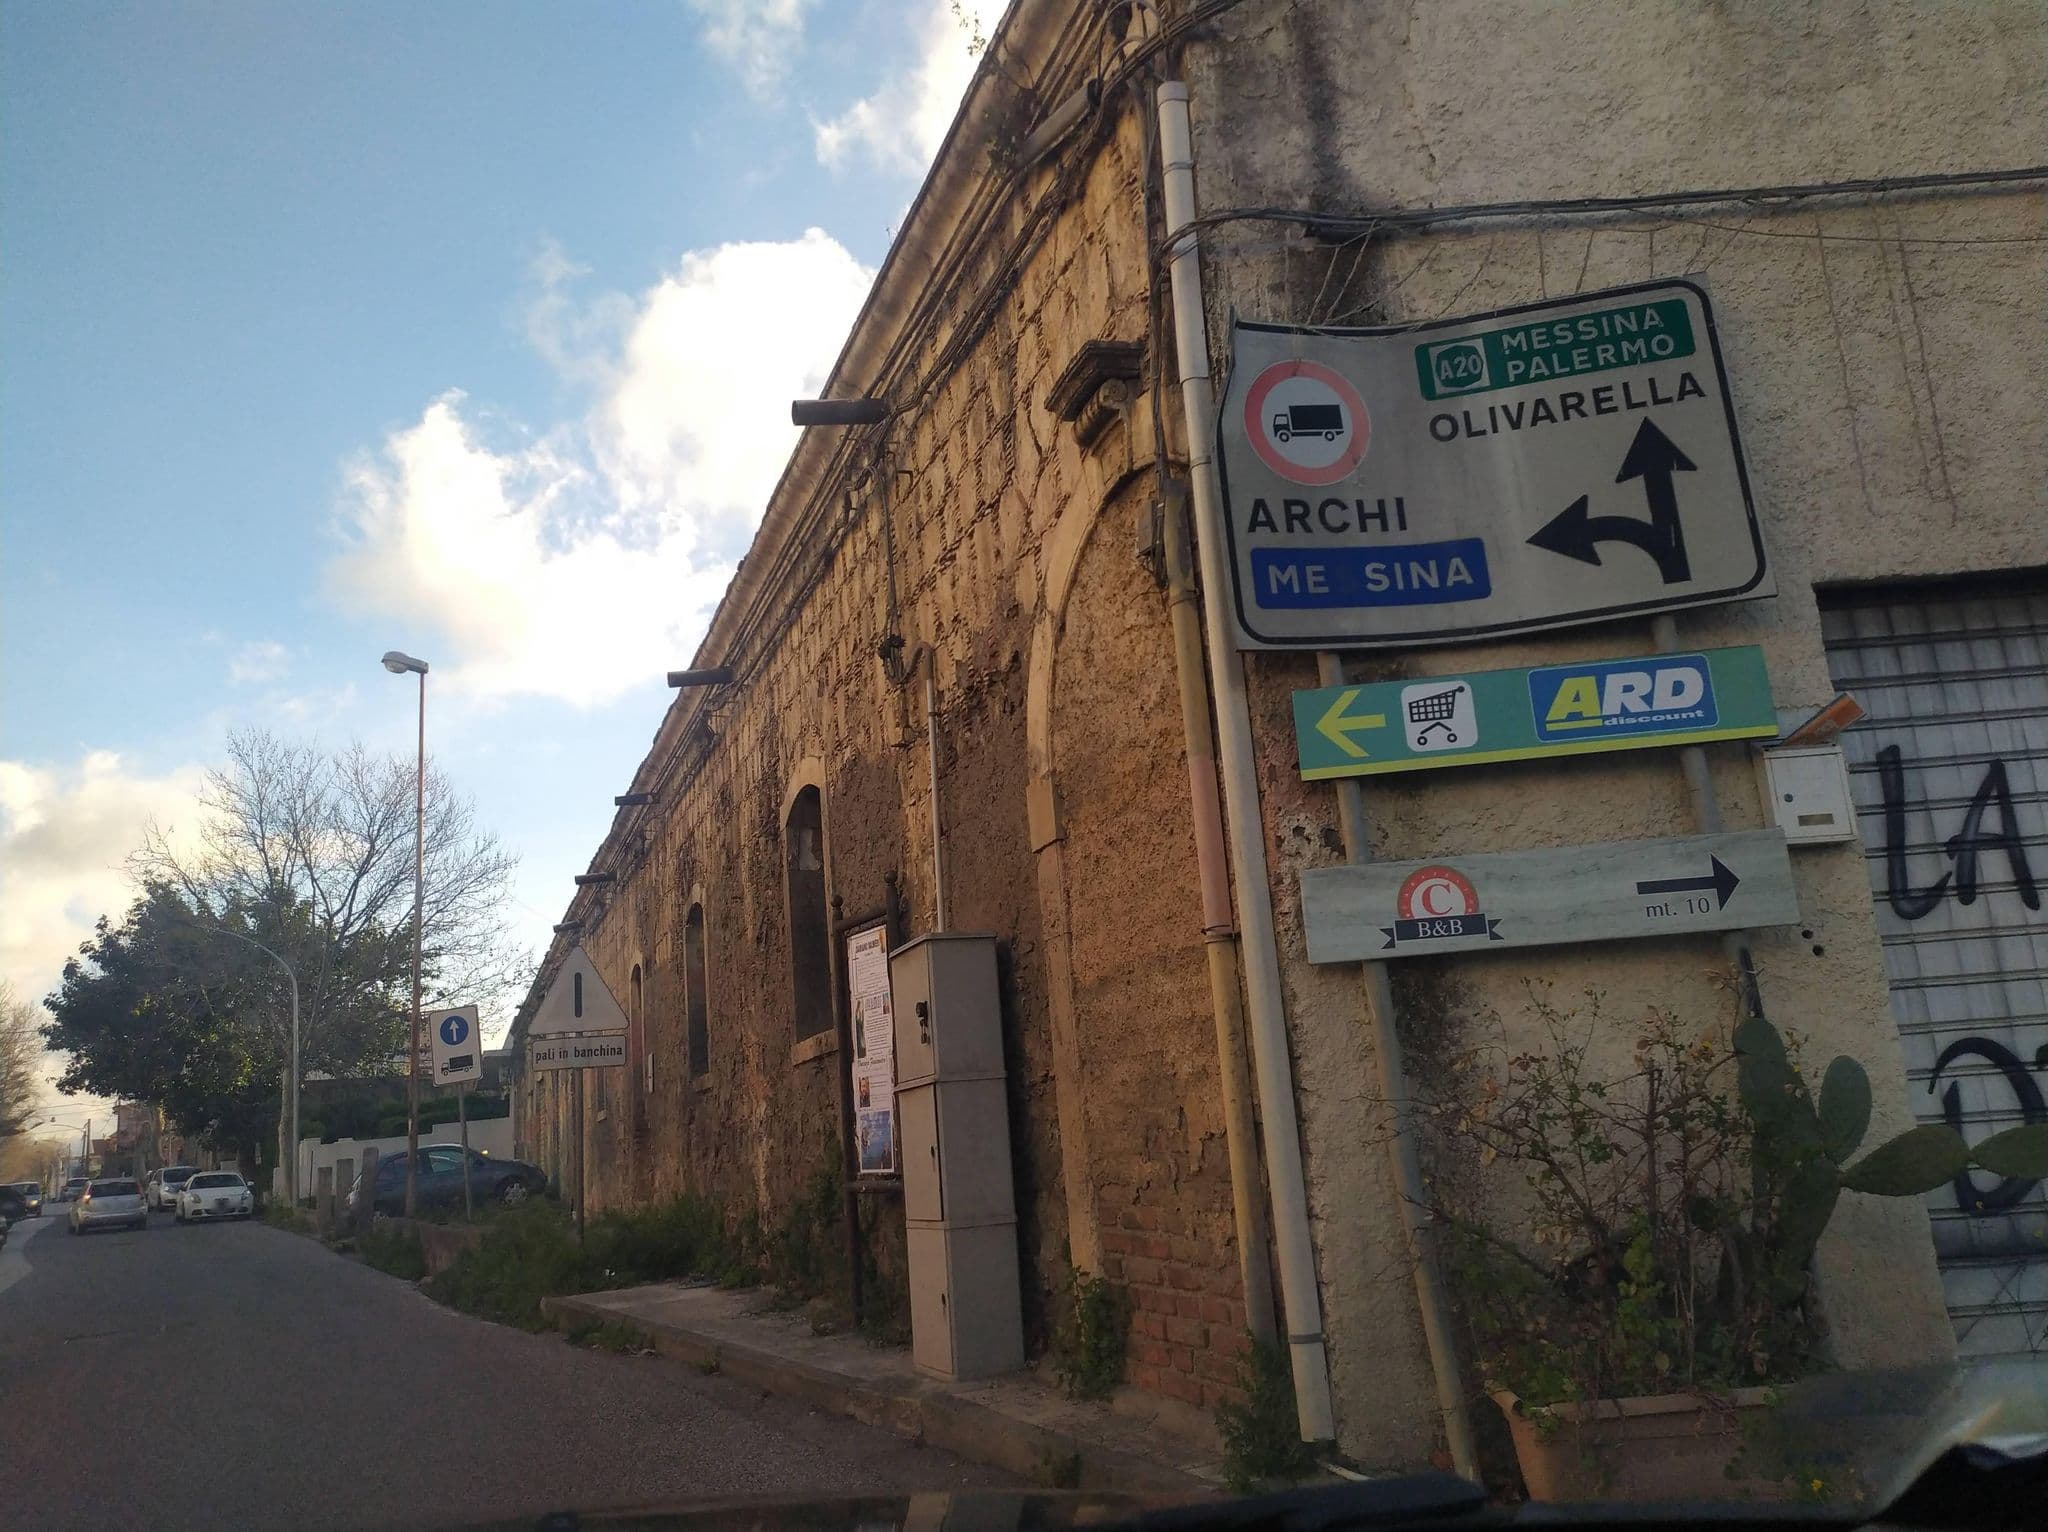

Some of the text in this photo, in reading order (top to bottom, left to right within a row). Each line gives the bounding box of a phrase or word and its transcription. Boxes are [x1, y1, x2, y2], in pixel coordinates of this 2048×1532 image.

[1501, 306, 1664, 354] MESSINA
[1438, 354, 1484, 381] A20
[1506, 334, 1675, 382] PALERMO
[1429, 371, 1707, 442] OLIVARELLA
[1247, 497, 1408, 534] ARCHI
[1546, 667, 1704, 721] ARD
[1604, 709, 1705, 726] discount
[1421, 883, 1453, 915] C
[1646, 897, 1710, 917] mt. 10
[1417, 919, 1463, 938] B&B
[535, 1044, 622, 1064] pali in banchina
